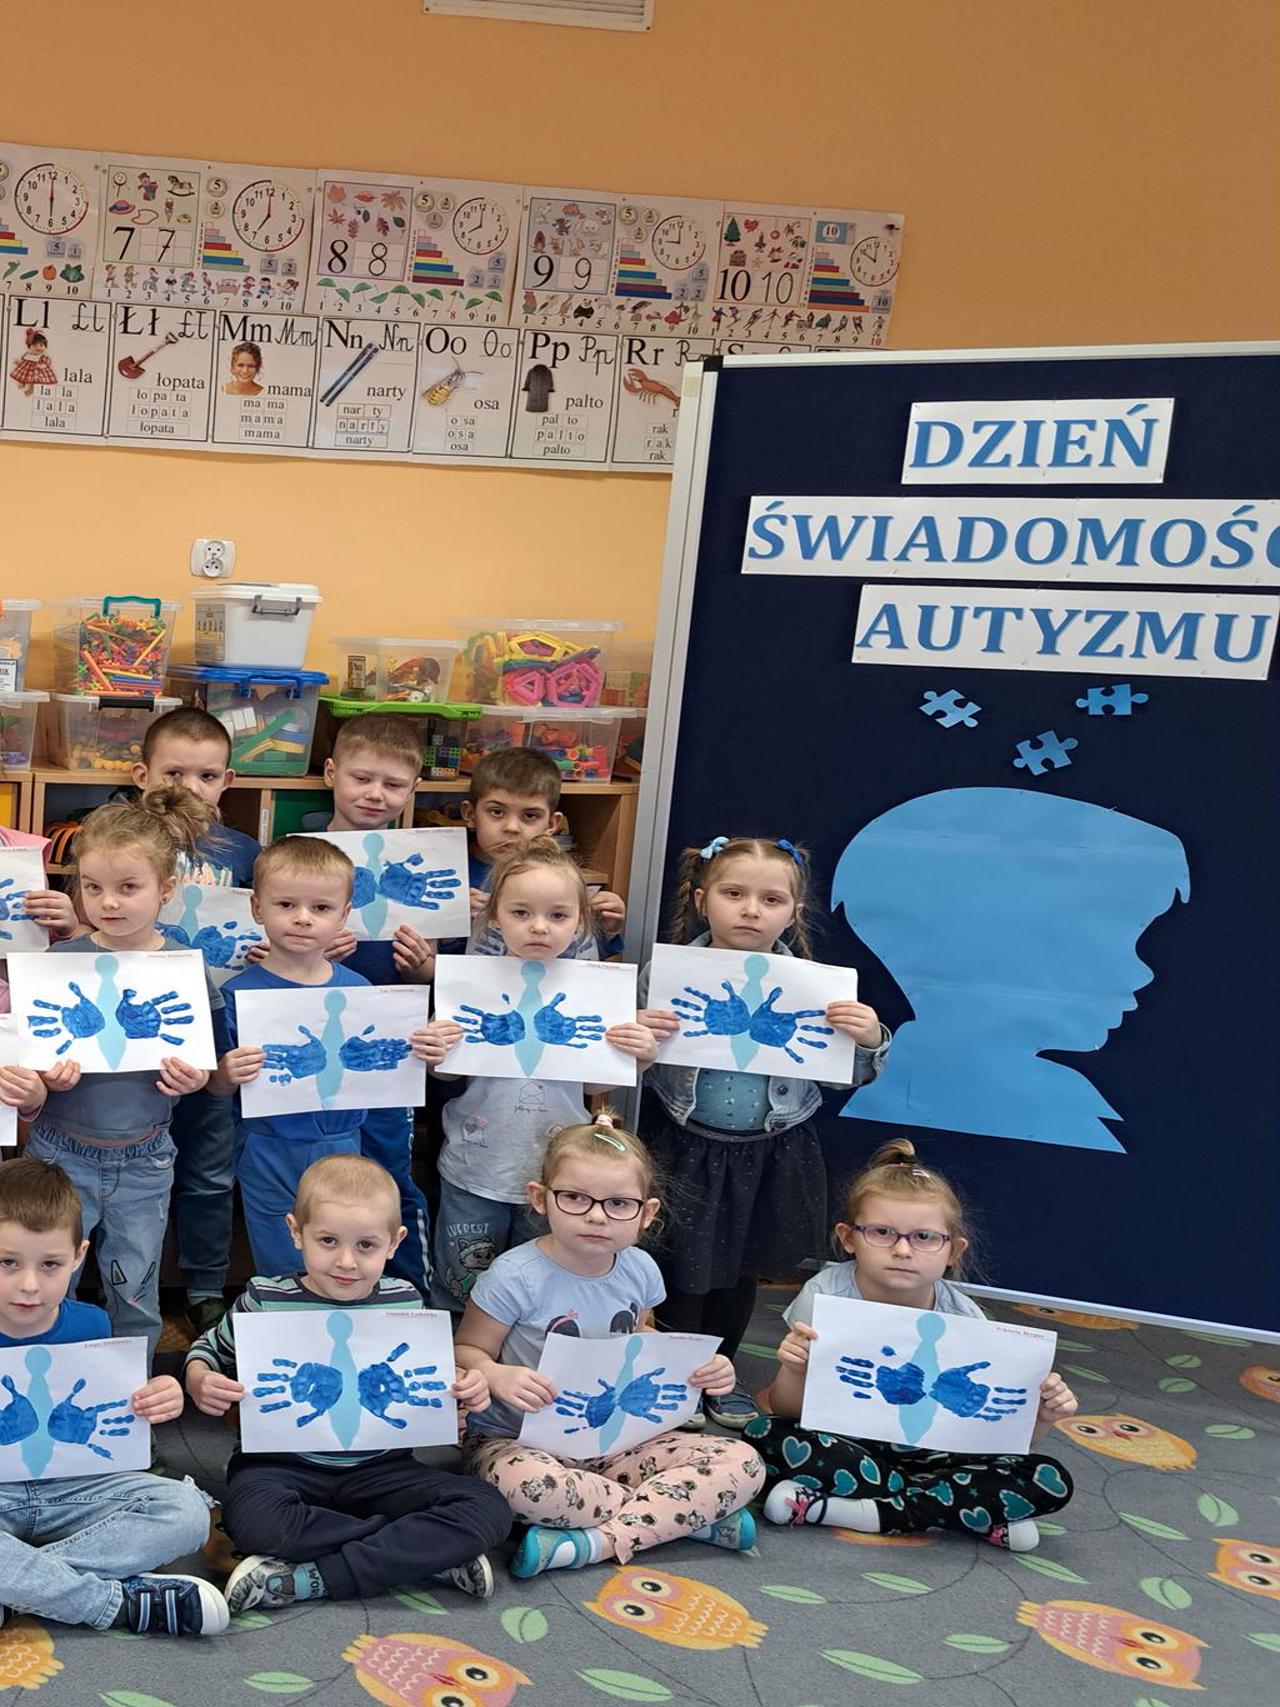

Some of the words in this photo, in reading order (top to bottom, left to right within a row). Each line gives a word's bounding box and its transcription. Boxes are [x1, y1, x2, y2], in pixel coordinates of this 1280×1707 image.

[114, 226, 135, 260] 7
[158, 229, 175, 262] 7
[327, 239, 349, 274] 8
[368, 242, 388, 276] 8
[533, 255, 554, 289] 9
[574, 258, 592, 291] 9
[717, 269, 751, 301] 10
[762, 272, 793, 304] 10
[14, 299, 50, 328] Ll
[71, 303, 104, 332] Ll
[221, 314, 273, 343] Mm
[275, 317, 317, 346] Mm
[325, 320, 363, 349] Nn
[379, 323, 415, 352] Nn
[426, 327, 467, 355] Oo
[484, 330, 512, 358] Oo
[625, 338, 664, 365] Rr
[675, 340, 704, 366] R
[528, 332, 570, 369] Pp
[579, 335, 614, 376] Pp
[64, 368, 93, 384] lala
[156, 372, 205, 391] łopata
[267, 385, 311, 397] mama
[366, 385, 406, 400] narty
[474, 399, 499, 410] osa
[565, 394, 604, 411] palto
[44, 416, 66, 428] lala
[139, 422, 174, 435] łopata
[244, 429, 280, 439] mama
[345, 435, 374, 446] narty
[909, 404, 1159, 468] DZIEŃ
[450, 442, 468, 451] osa
[543, 444, 571, 456] palto
[649, 450, 666, 460] rak
[855, 604, 1272, 662] AUTYZMU
